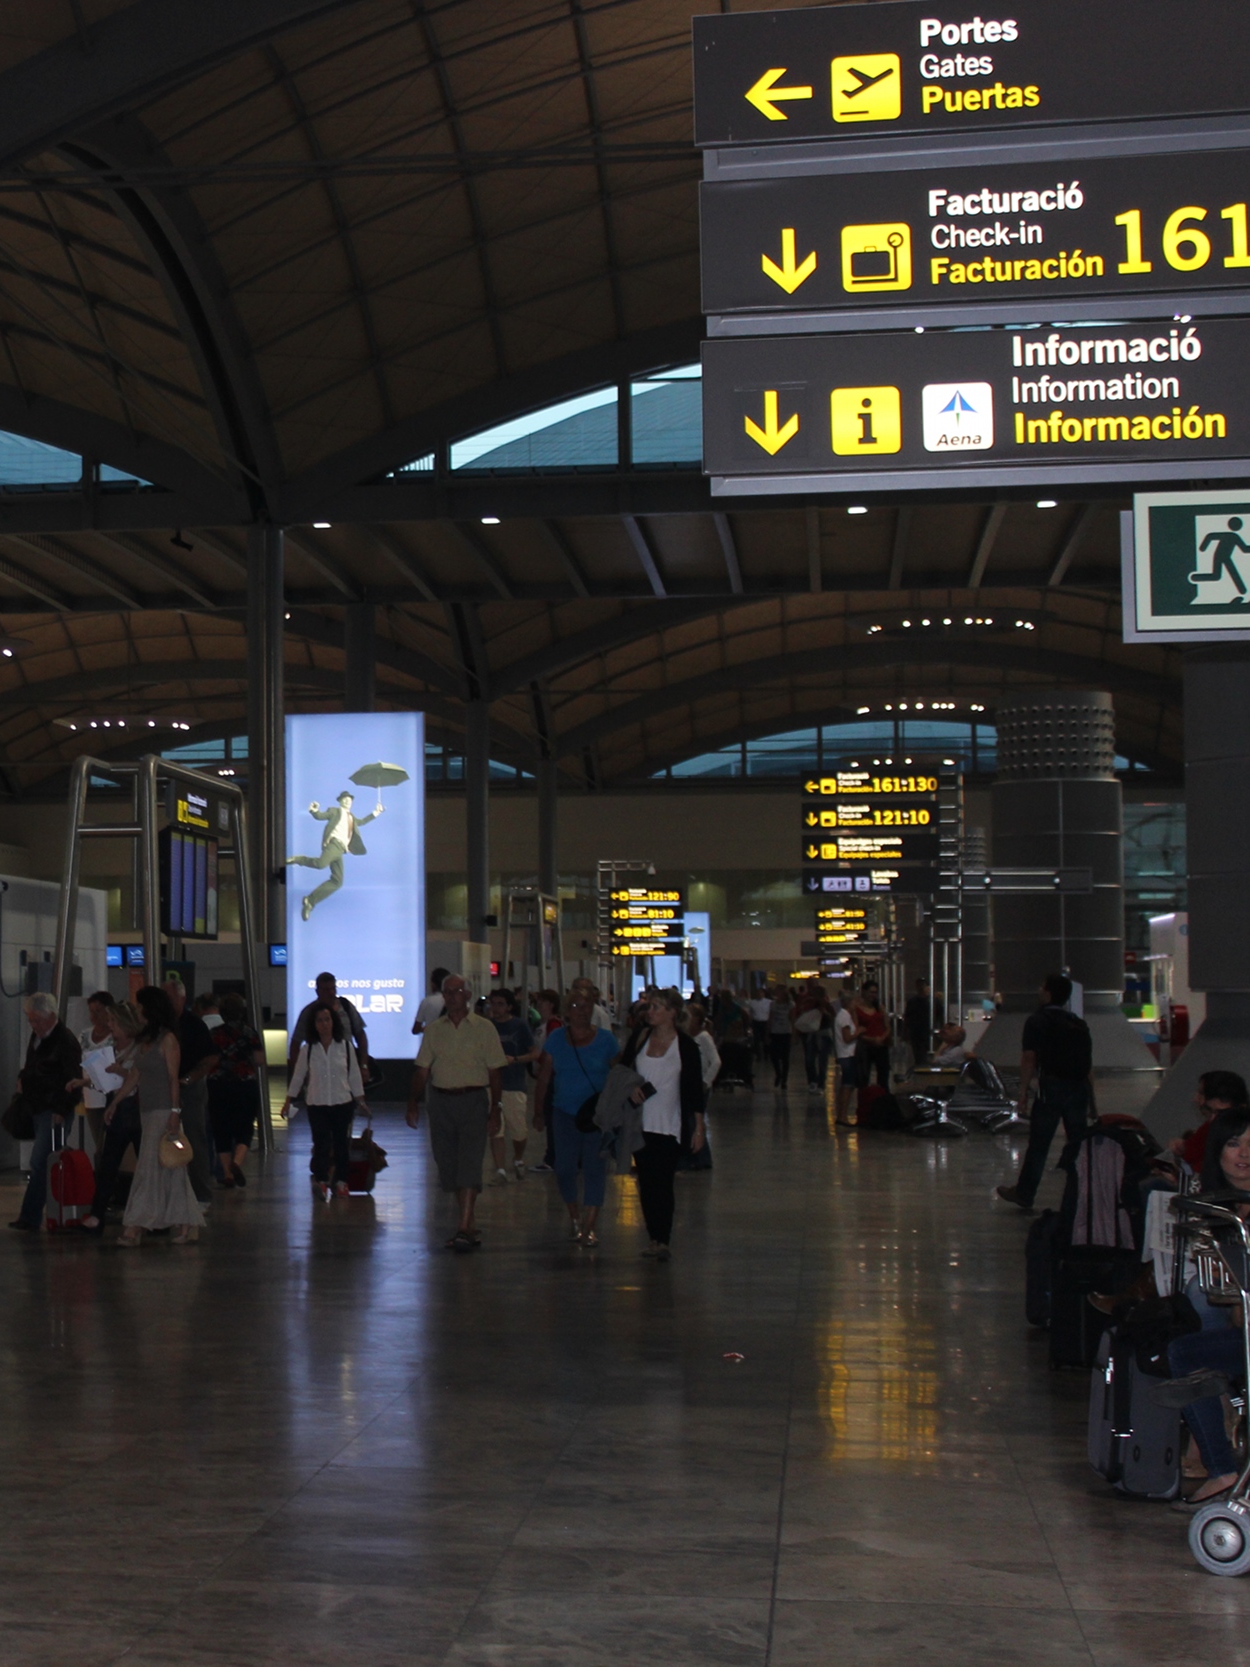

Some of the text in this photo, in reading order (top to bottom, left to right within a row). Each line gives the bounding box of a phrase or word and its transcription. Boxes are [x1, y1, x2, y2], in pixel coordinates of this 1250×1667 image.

[920, 16, 1018, 47] Portes
[920, 53, 994, 79] Gates
[922, 82, 1041, 114] Puertas
[928, 181, 1084, 217] Facturació
[931, 221, 1043, 249] Check-in
[930, 249, 1104, 285] Facturación
[1011, 328, 1202, 367] Informació
[1012, 372, 1180, 404] Information
[936, 431, 982, 447] Aena
[1015, 406, 1226, 444] Información
[351, 979, 372, 988] nos
[373, 978, 405, 990] gusta
